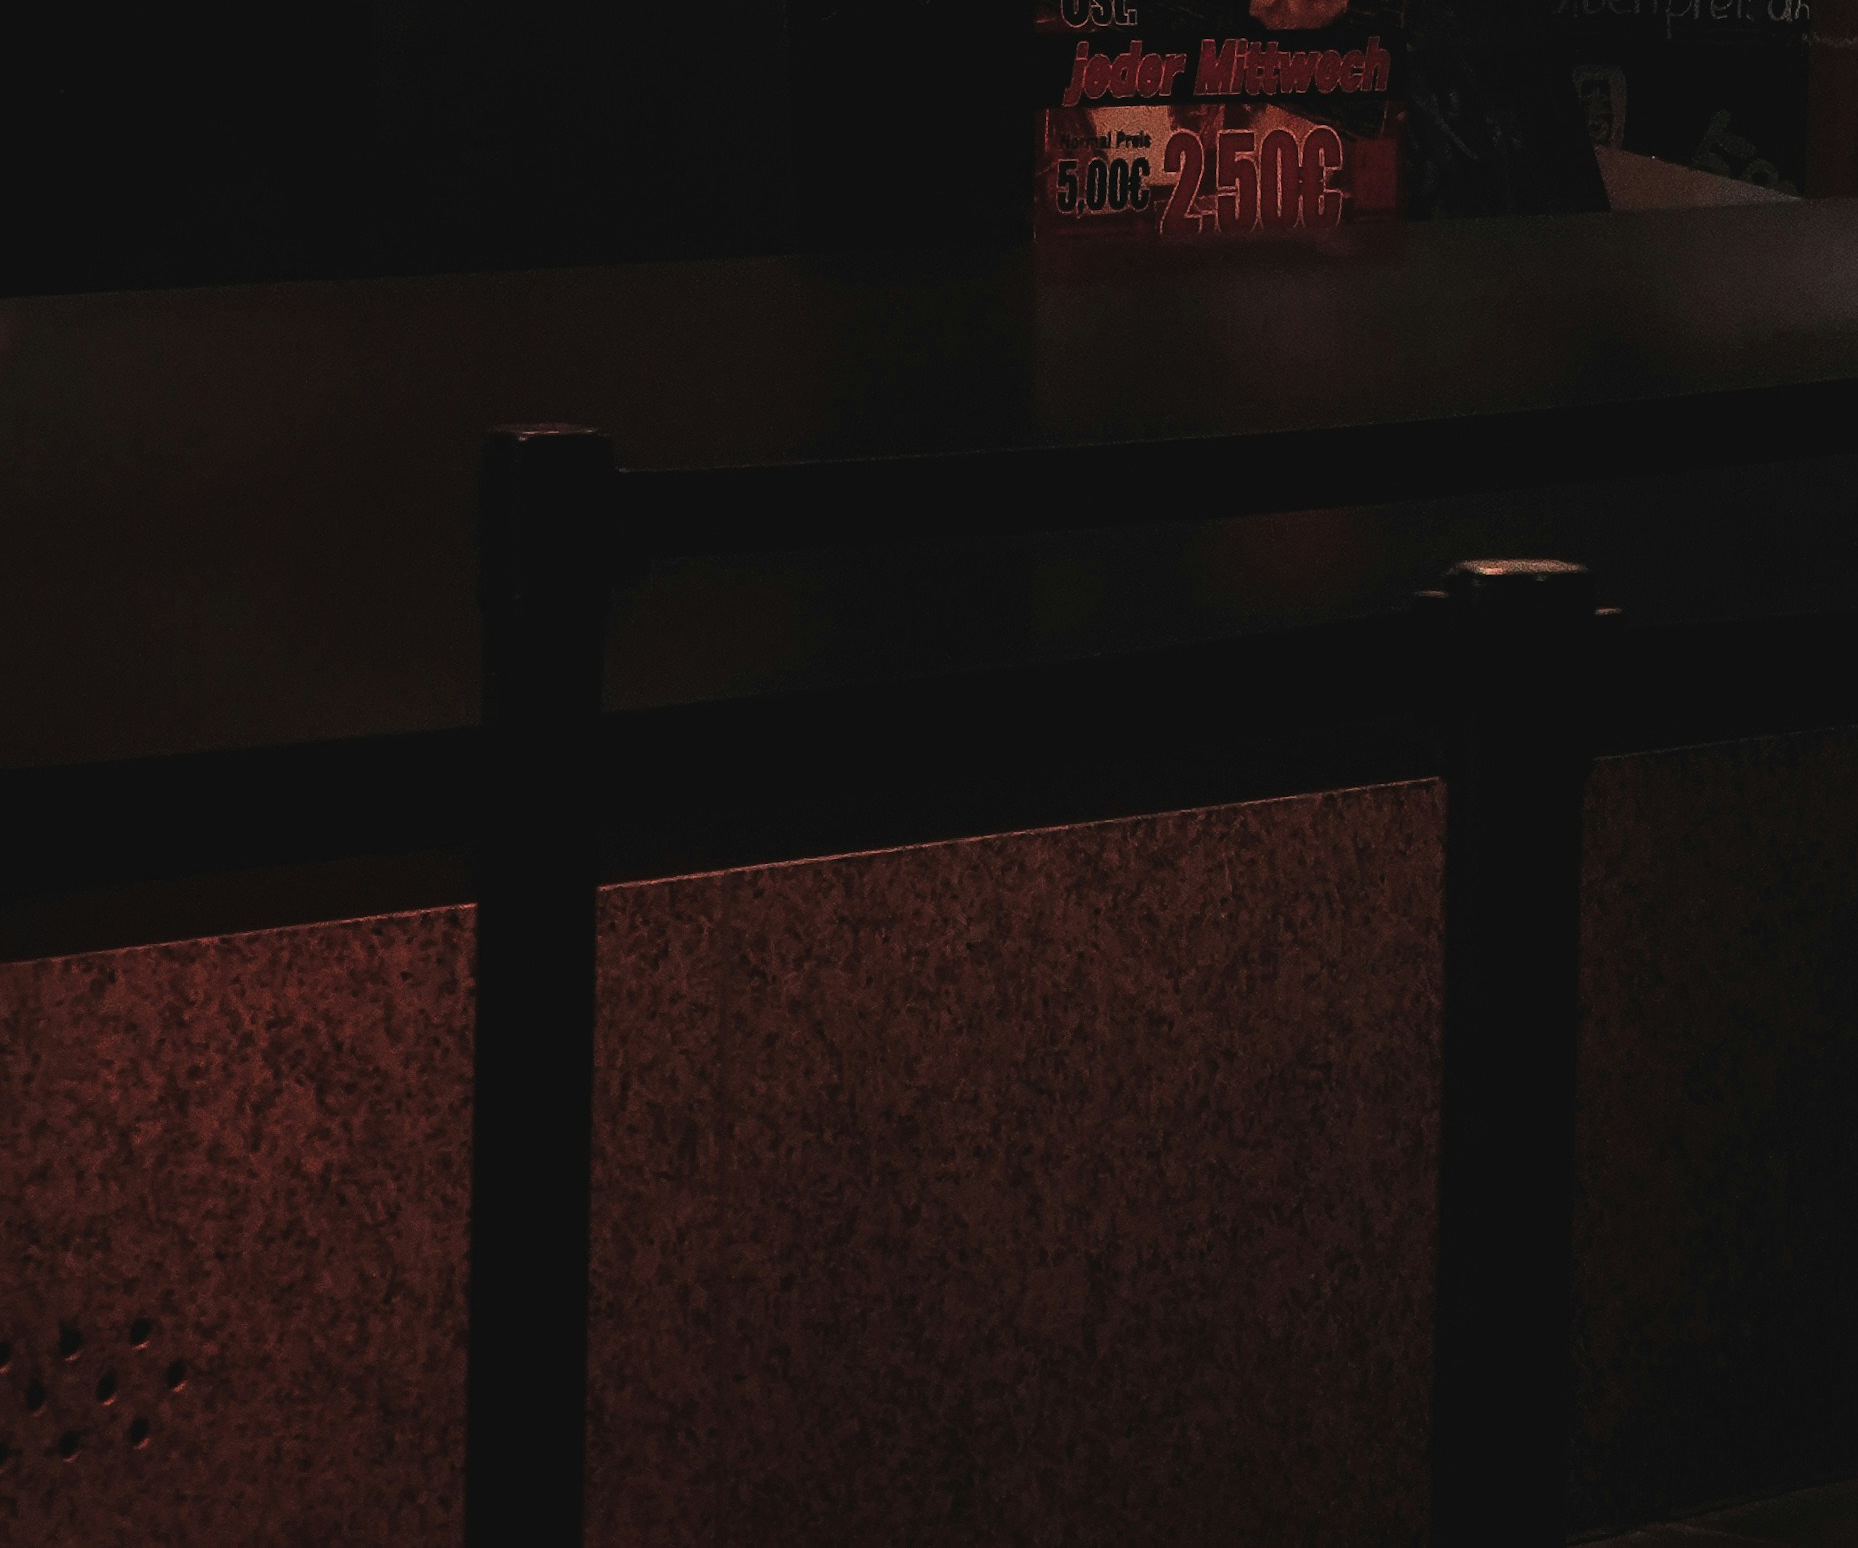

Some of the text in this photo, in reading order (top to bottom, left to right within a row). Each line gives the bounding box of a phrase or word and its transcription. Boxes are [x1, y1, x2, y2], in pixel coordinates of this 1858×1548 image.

[1062, 35, 1392, 107] jeder Mittwoch
[1055, 156, 1152, 219] 5,00€
